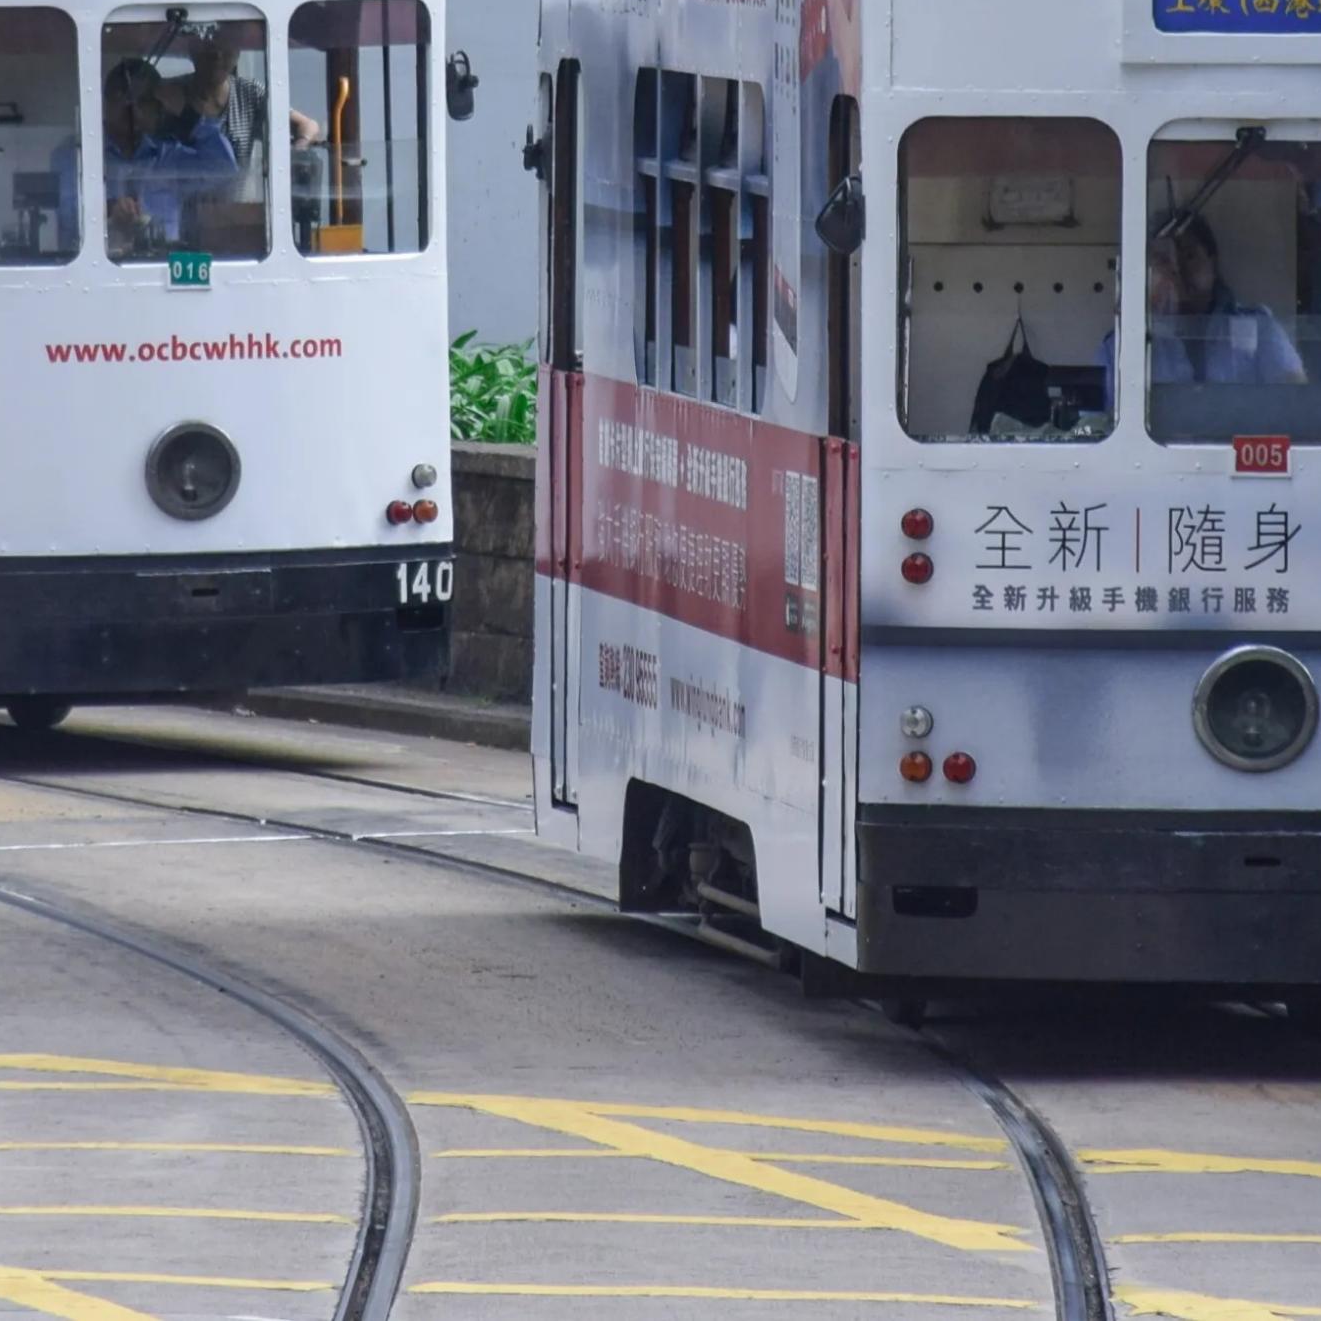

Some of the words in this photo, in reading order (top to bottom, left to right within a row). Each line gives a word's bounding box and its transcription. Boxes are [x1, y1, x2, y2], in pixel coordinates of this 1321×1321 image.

[172, 261, 209, 281] 016
[46, 333, 342, 363] www.ocbcwhhk.com
[1240, 443, 1283, 467] 005
[395, 560, 454, 604] 140
[972, 585, 1290, 615] 全新升級手機銀行服務
